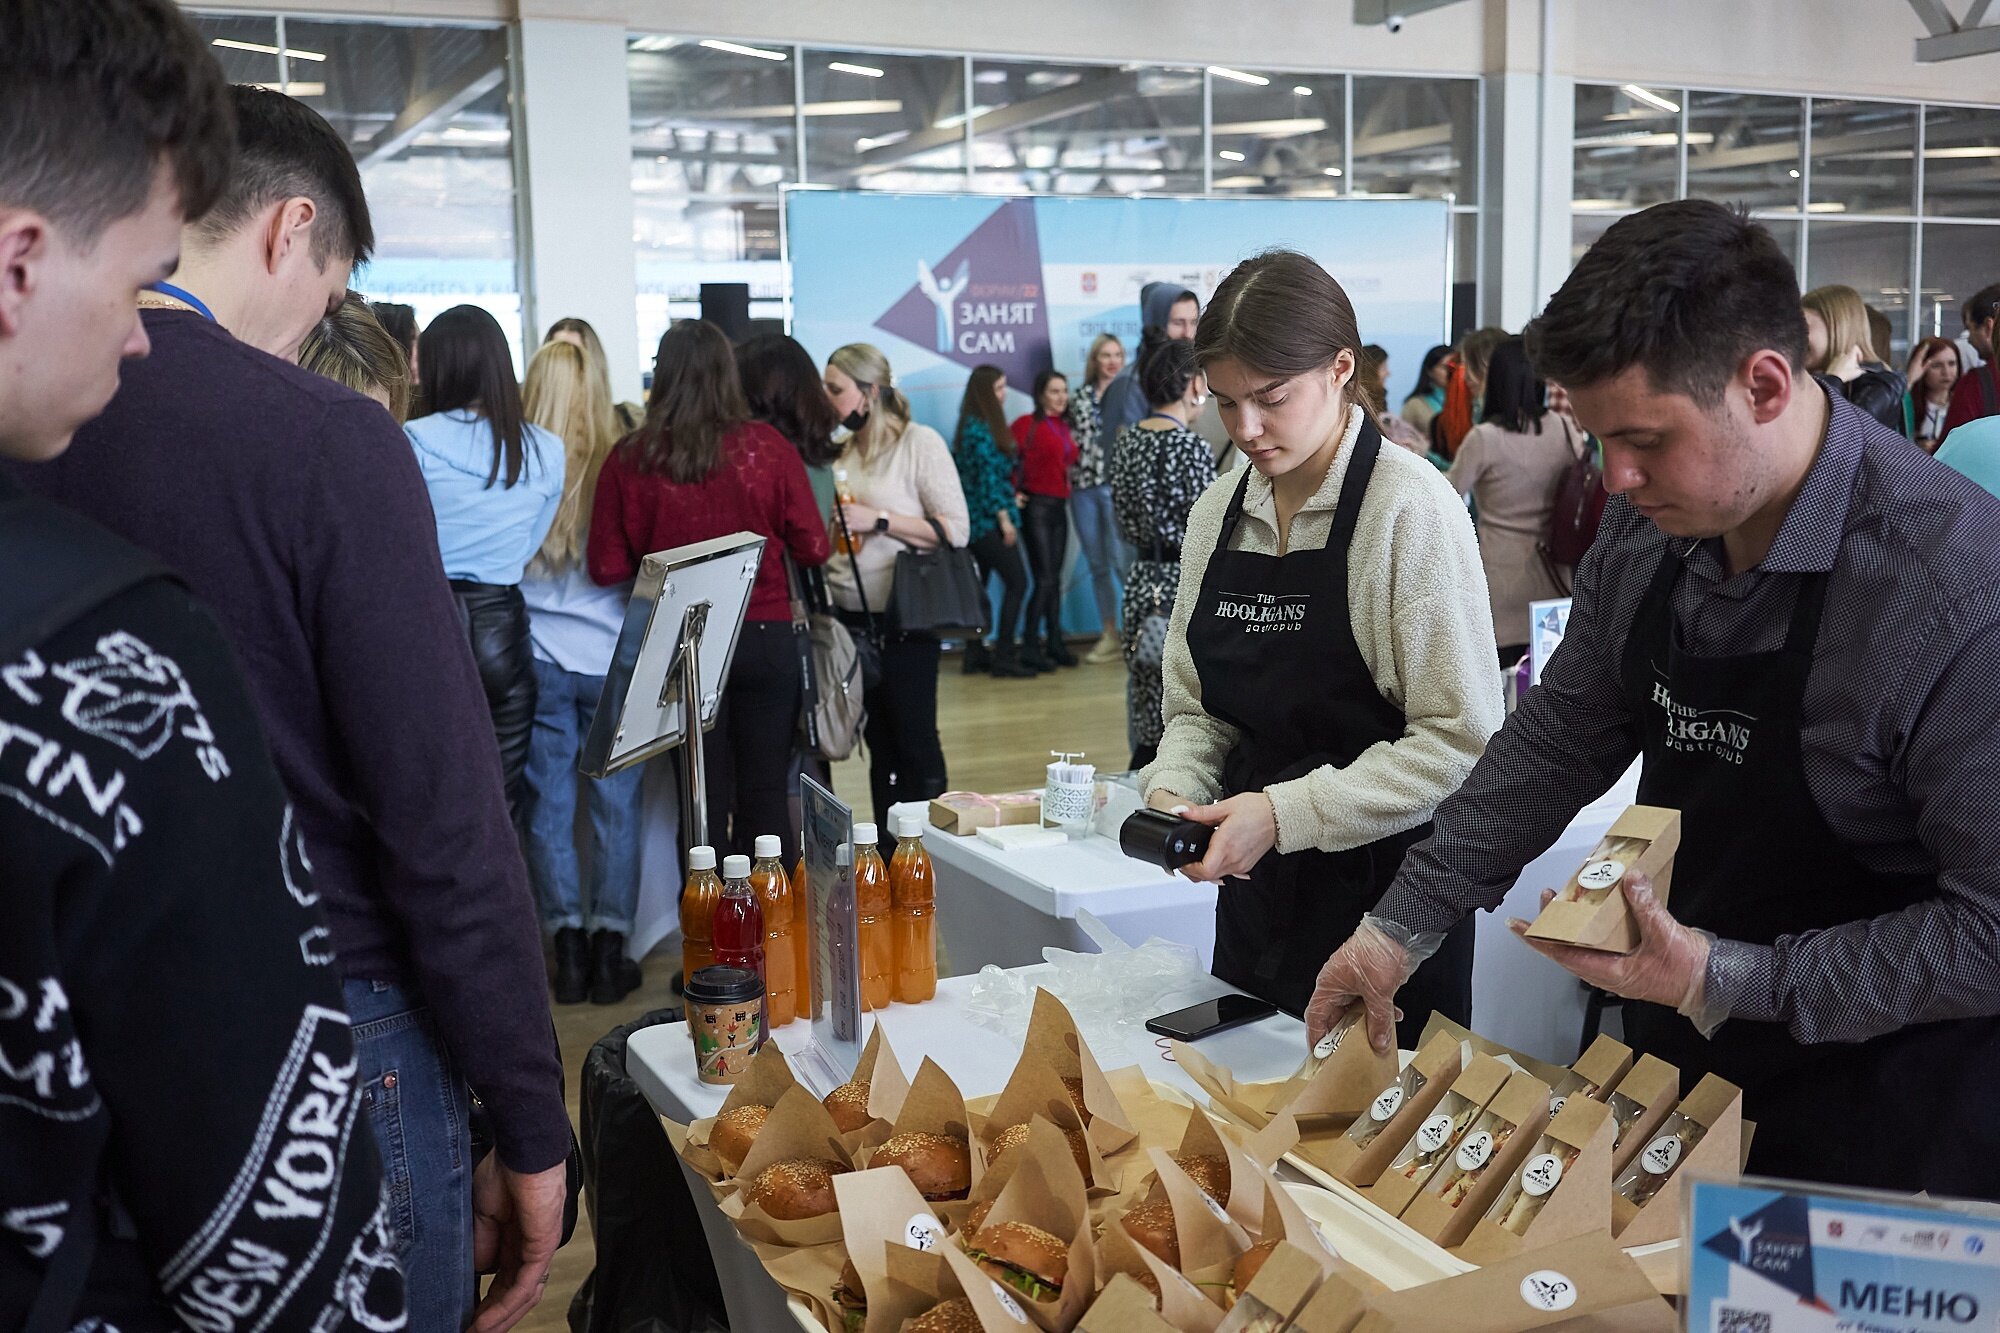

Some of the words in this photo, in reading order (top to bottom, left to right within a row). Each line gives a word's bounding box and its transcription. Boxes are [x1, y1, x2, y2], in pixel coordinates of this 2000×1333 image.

[959, 302, 1036, 325] ЗАНЯТ
[958, 331, 1015, 354] САМ
[1214, 601, 1306, 622] HOOLIGANS
[1670, 701, 1698, 719] THE
[173, 1238, 289, 1333] NEW
[253, 1051, 358, 1222] YORK
[1840, 1278, 1979, 1324] МЕНЮ
